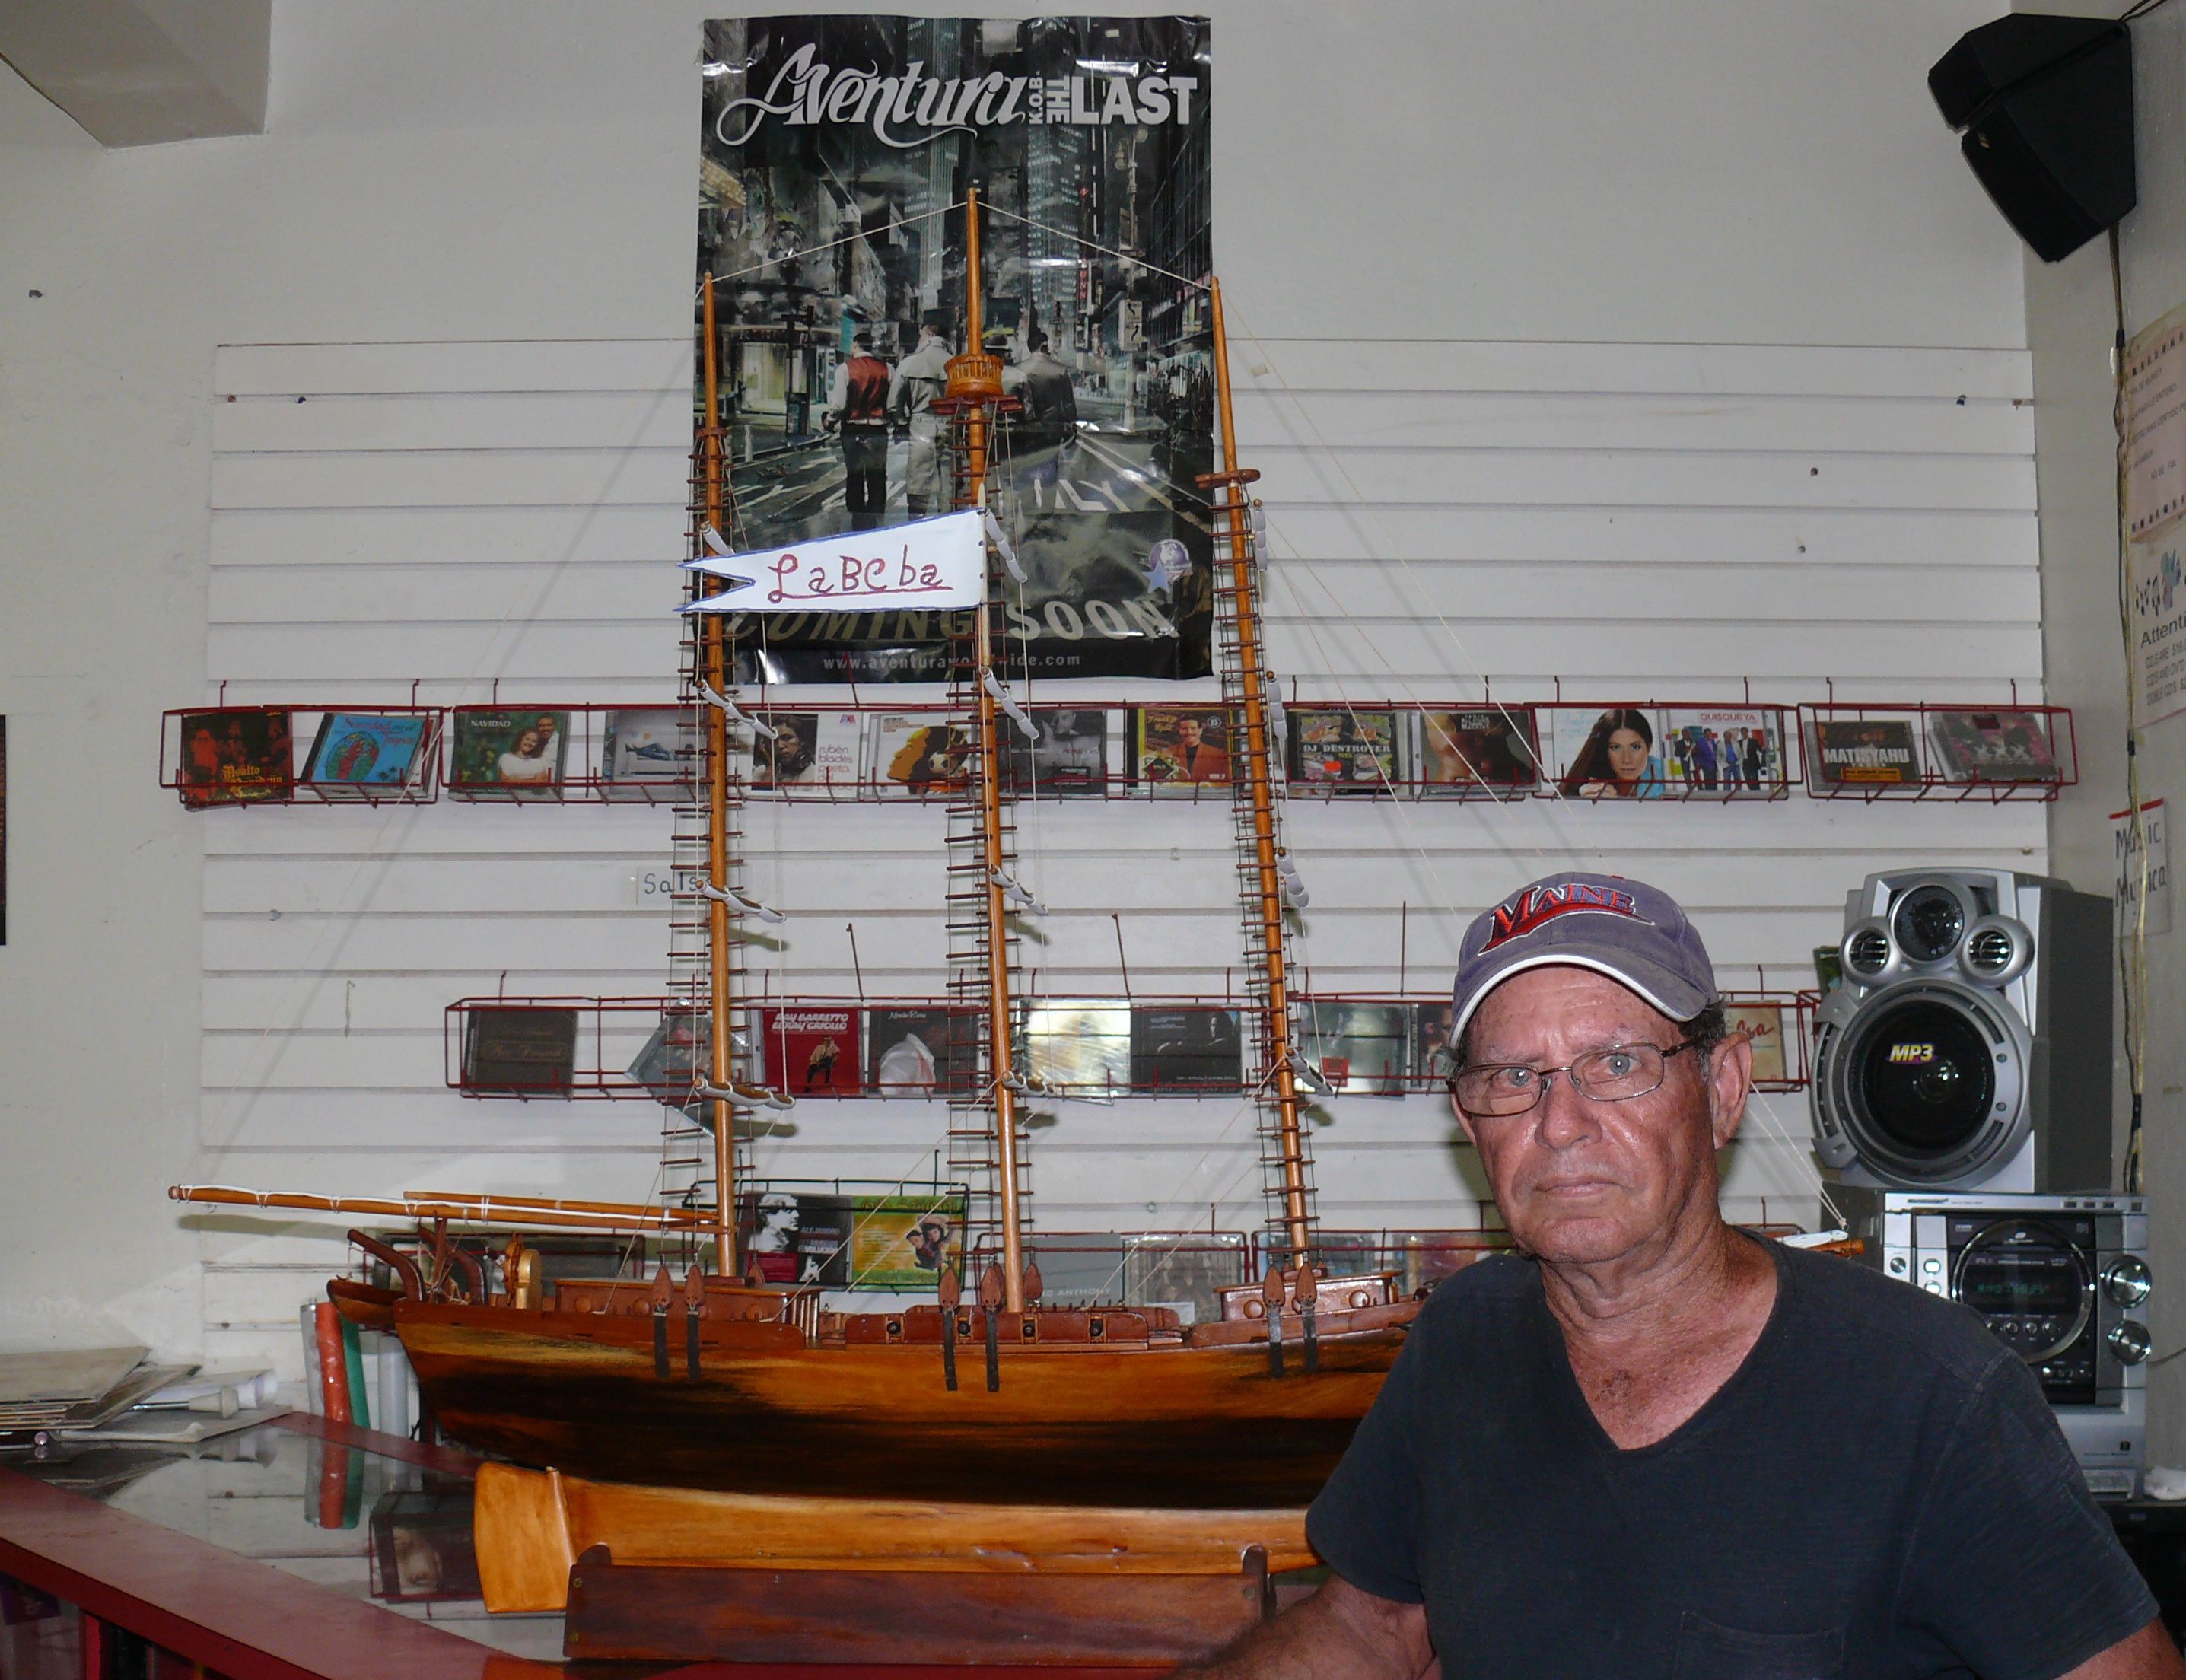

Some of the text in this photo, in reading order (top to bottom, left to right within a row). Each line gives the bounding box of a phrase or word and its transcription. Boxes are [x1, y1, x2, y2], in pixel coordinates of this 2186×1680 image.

[716, 43, 1027, 148] Aventura
[1046, 76, 1070, 124] THE
[1071, 76, 1198, 125] LAST
[1006, 600, 1181, 641] SOON
[2115, 816, 2162, 860] Muic
[2115, 866, 2168, 908] Muica
[1478, 883, 1637, 956] MAINE
[1890, 1044, 1933, 1062] MP3
